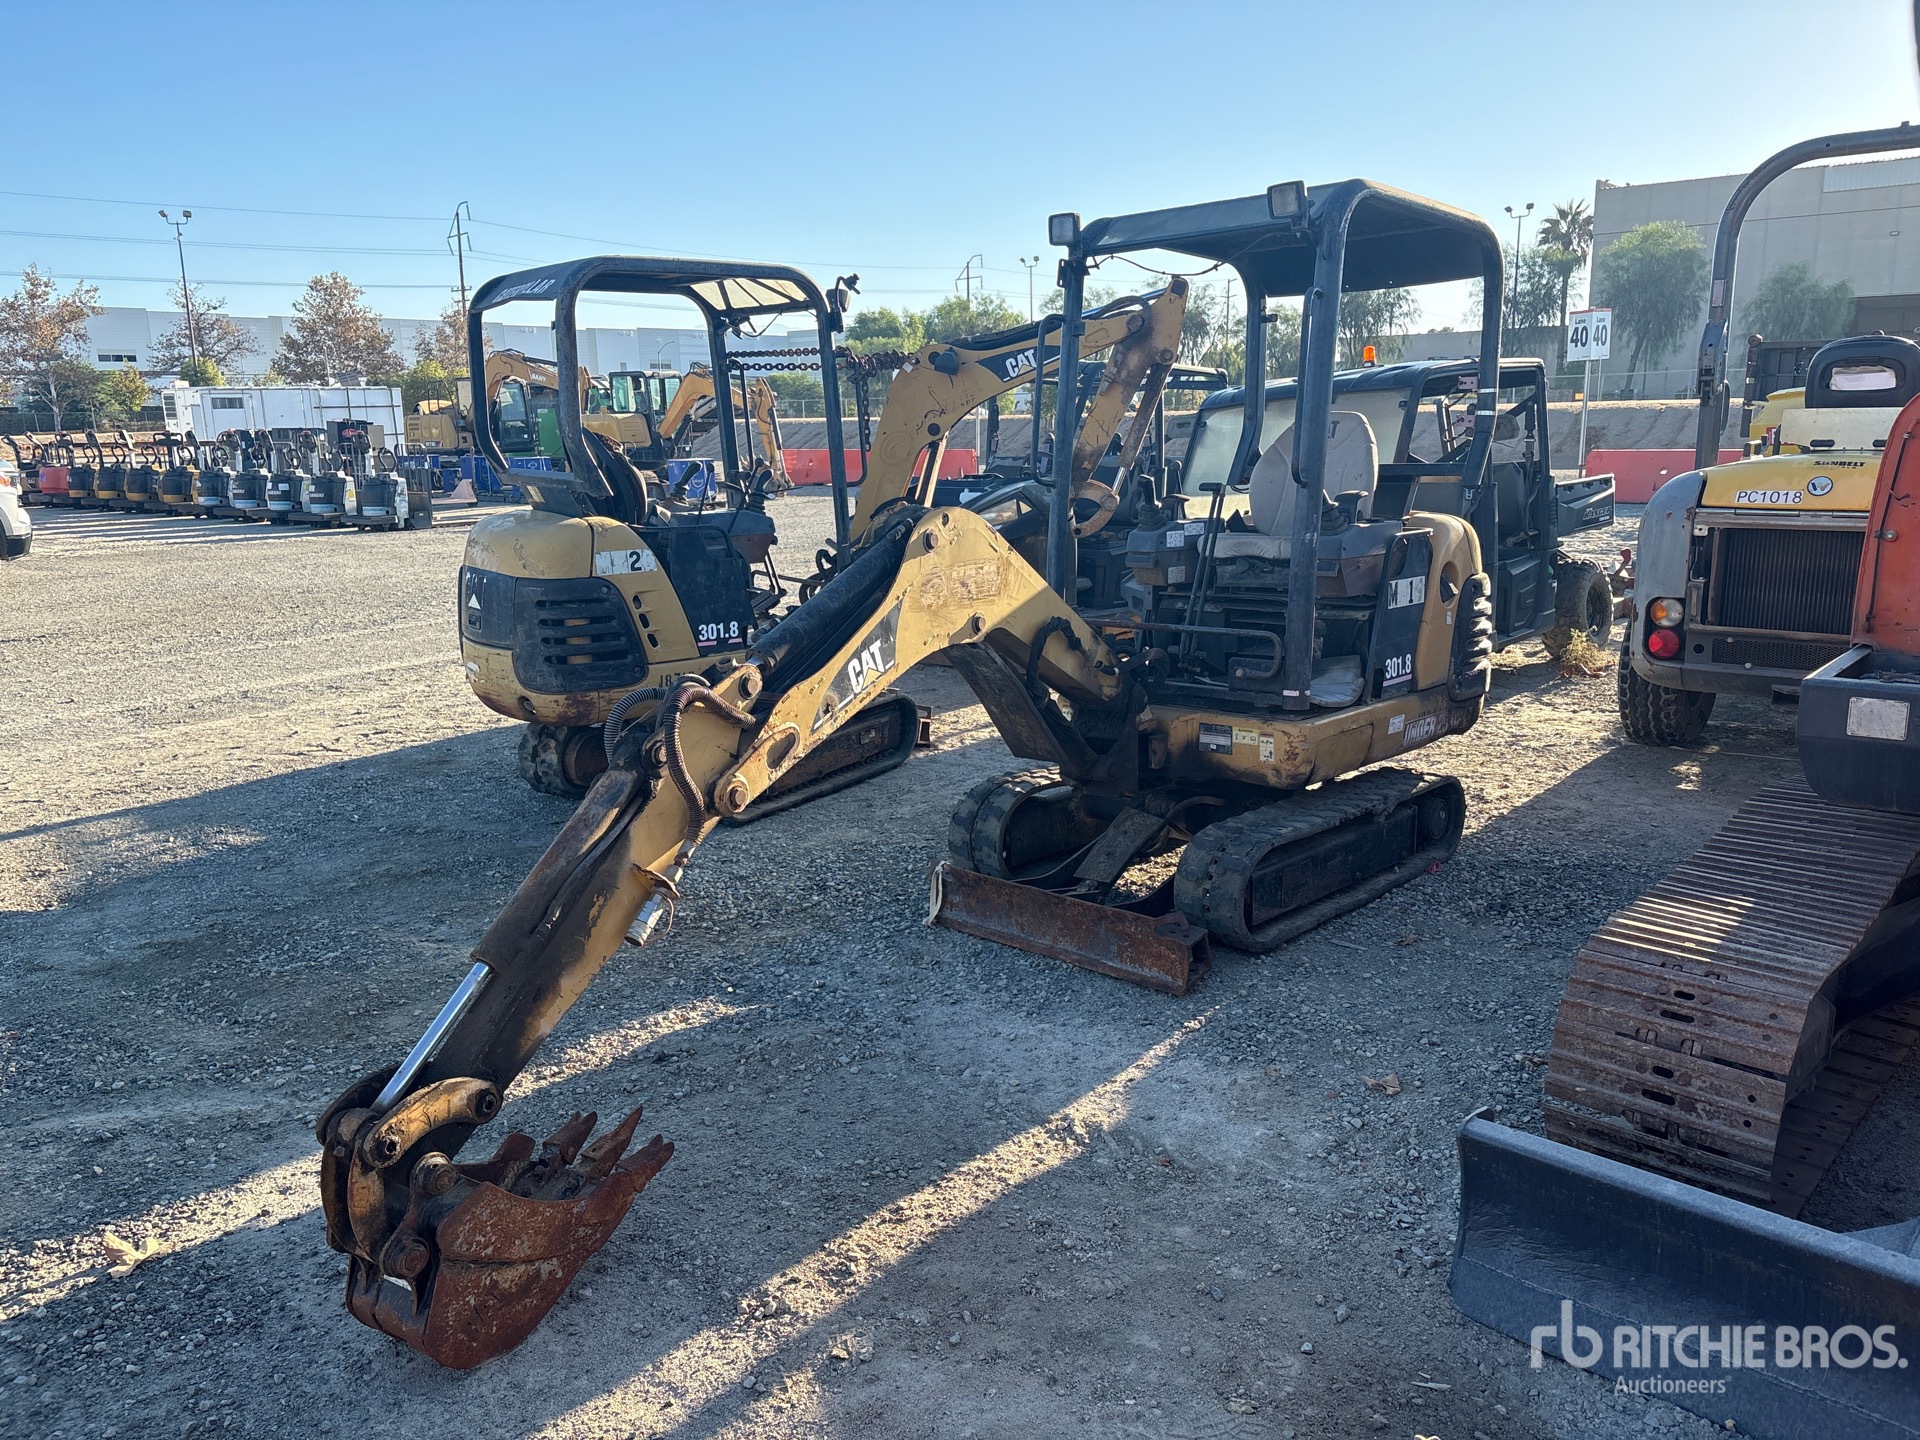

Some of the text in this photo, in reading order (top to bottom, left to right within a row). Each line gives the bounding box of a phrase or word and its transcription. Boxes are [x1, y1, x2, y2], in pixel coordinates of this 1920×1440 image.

[1570, 325, 1589, 348] 40
[1592, 324, 1608, 346] 40
[1005, 349, 1037, 378] CAT
[1813, 460, 1867, 468] SUNBELT
[1736, 491, 1803, 504] PC1018
[698, 621, 739, 641] 301.8
[847, 638, 885, 694] CAT
[1385, 653, 1412, 679] 301.8
